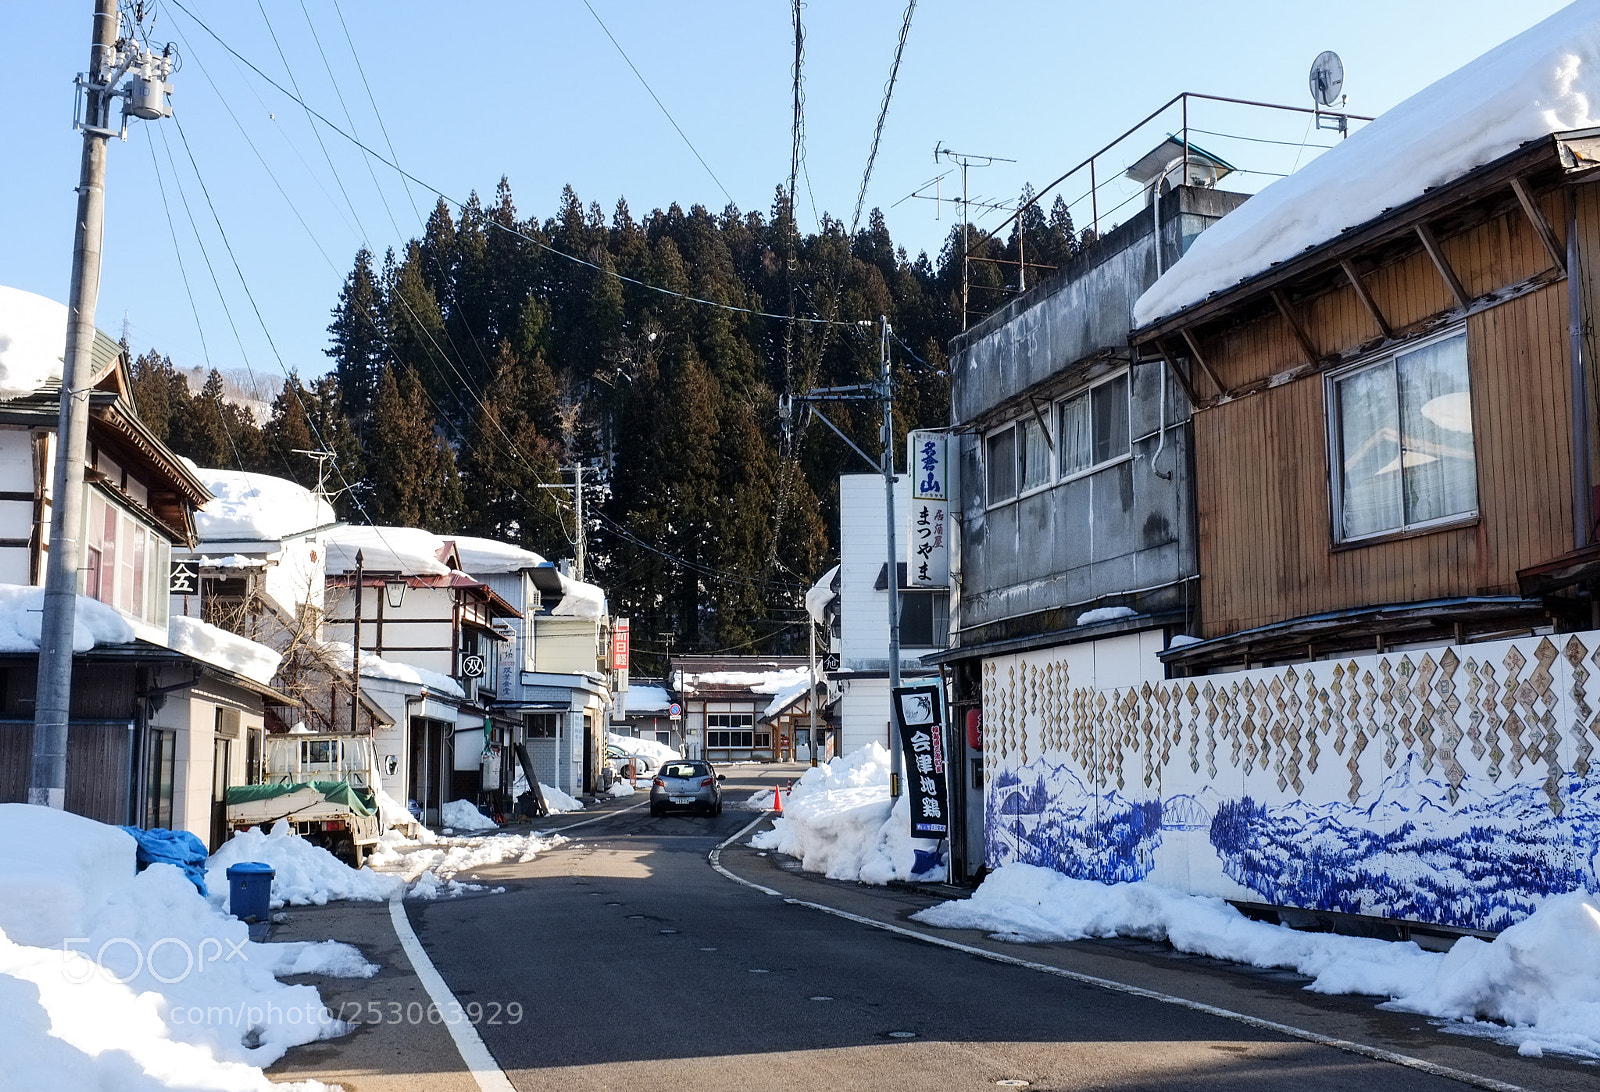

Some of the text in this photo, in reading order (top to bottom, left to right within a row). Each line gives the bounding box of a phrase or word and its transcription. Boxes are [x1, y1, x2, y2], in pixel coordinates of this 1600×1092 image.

[917, 506, 932, 581] まつやま
[933, 509, 944, 548] 居酒屋
[616, 630, 627, 666] 新日軽
[911, 730, 941, 818] 会津地鶏
